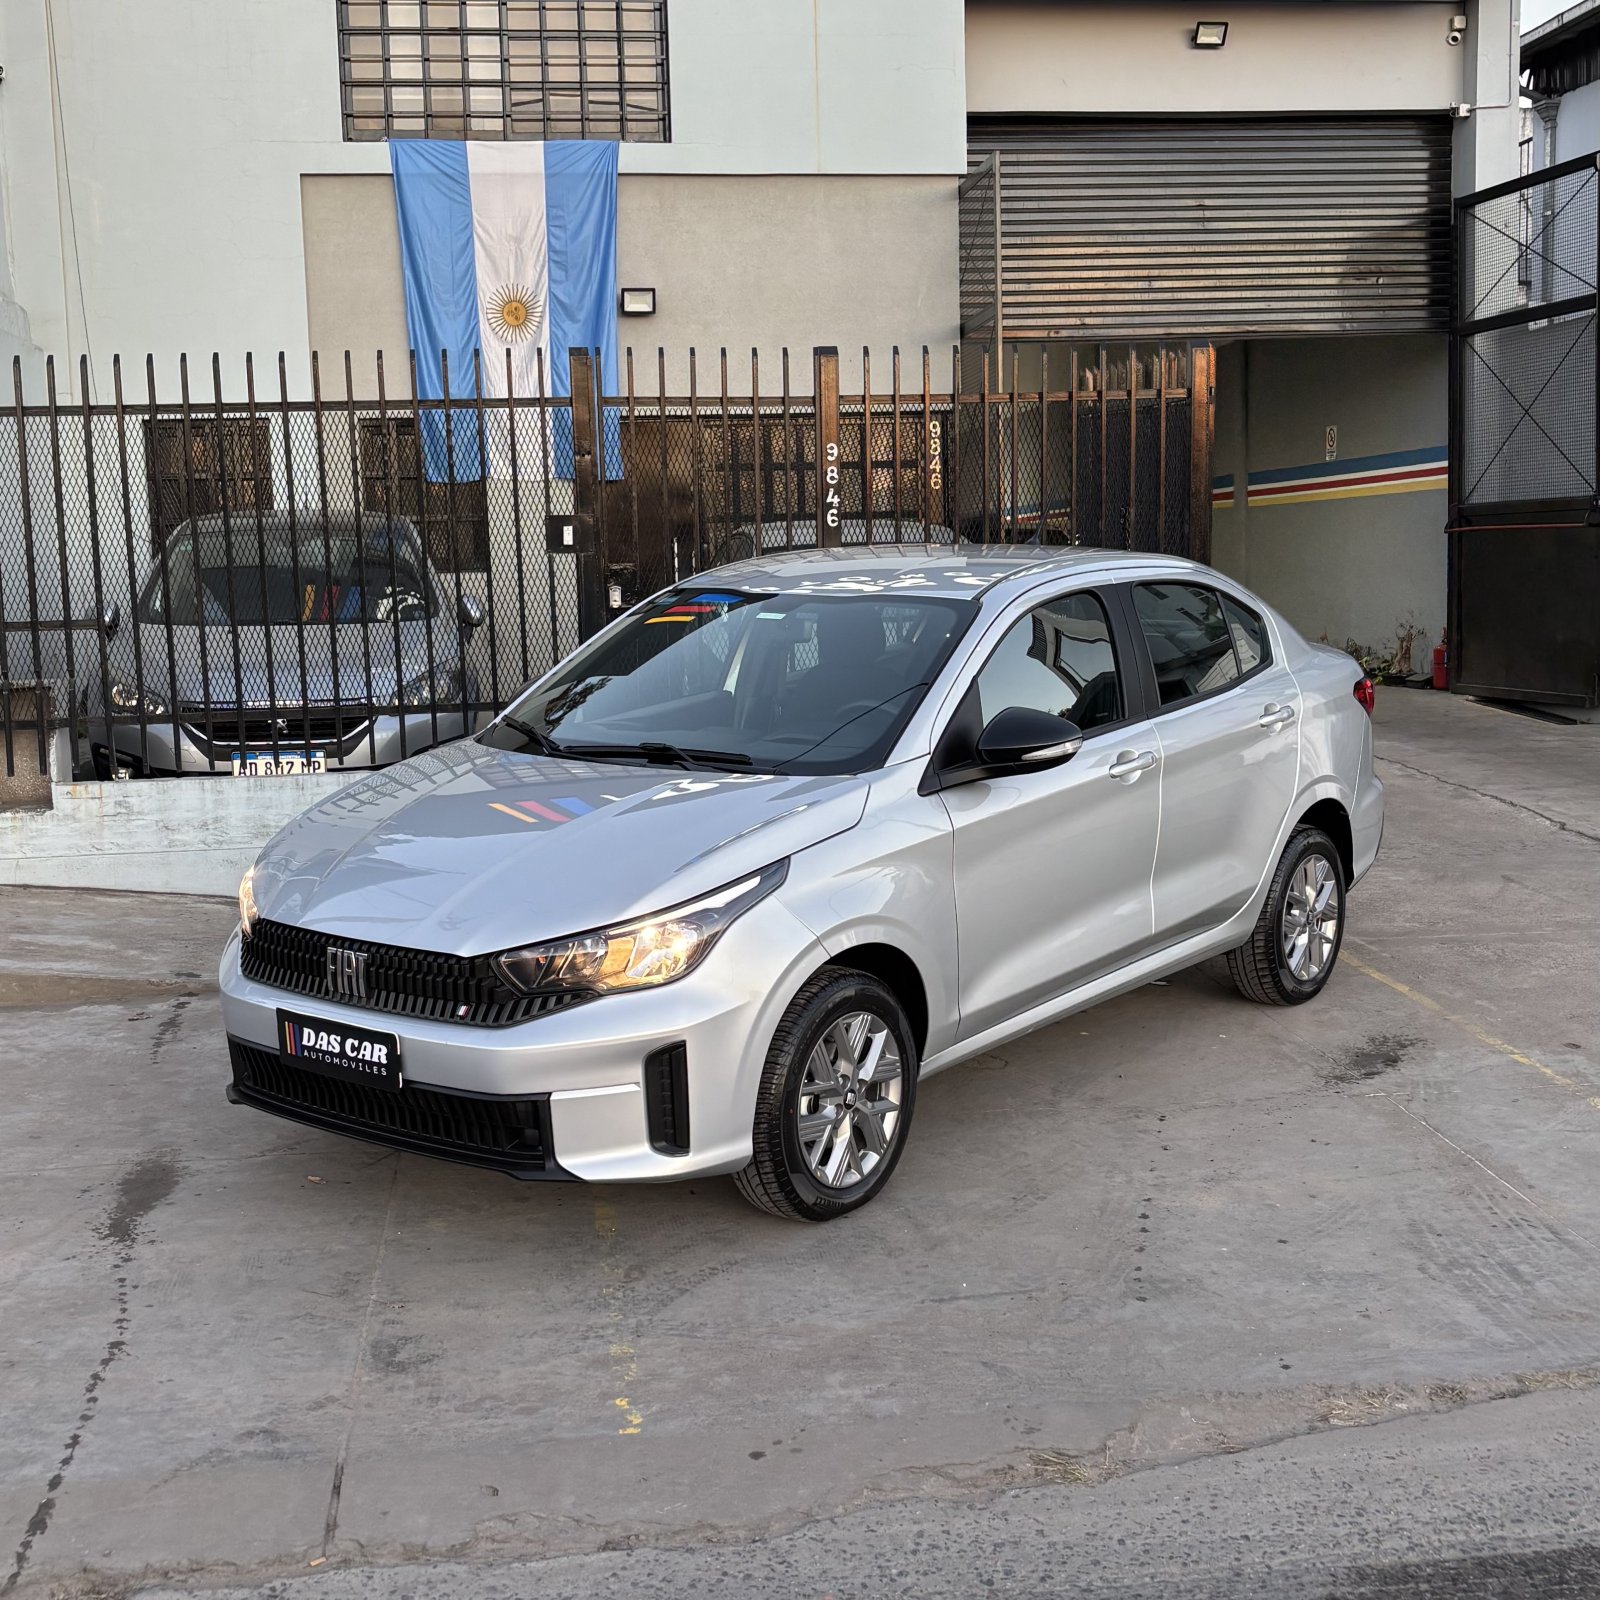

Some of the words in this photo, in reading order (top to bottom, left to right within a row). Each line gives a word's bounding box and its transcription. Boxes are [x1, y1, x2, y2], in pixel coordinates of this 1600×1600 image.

[929, 420, 941, 490] 9846
[826, 442, 841, 527] 9846
[326, 946, 368, 997] FIAT
[301, 1027, 341, 1054] DAS
[344, 1038, 388, 1064] CAR
[303, 1049, 387, 1076] AUTOMOVILES
